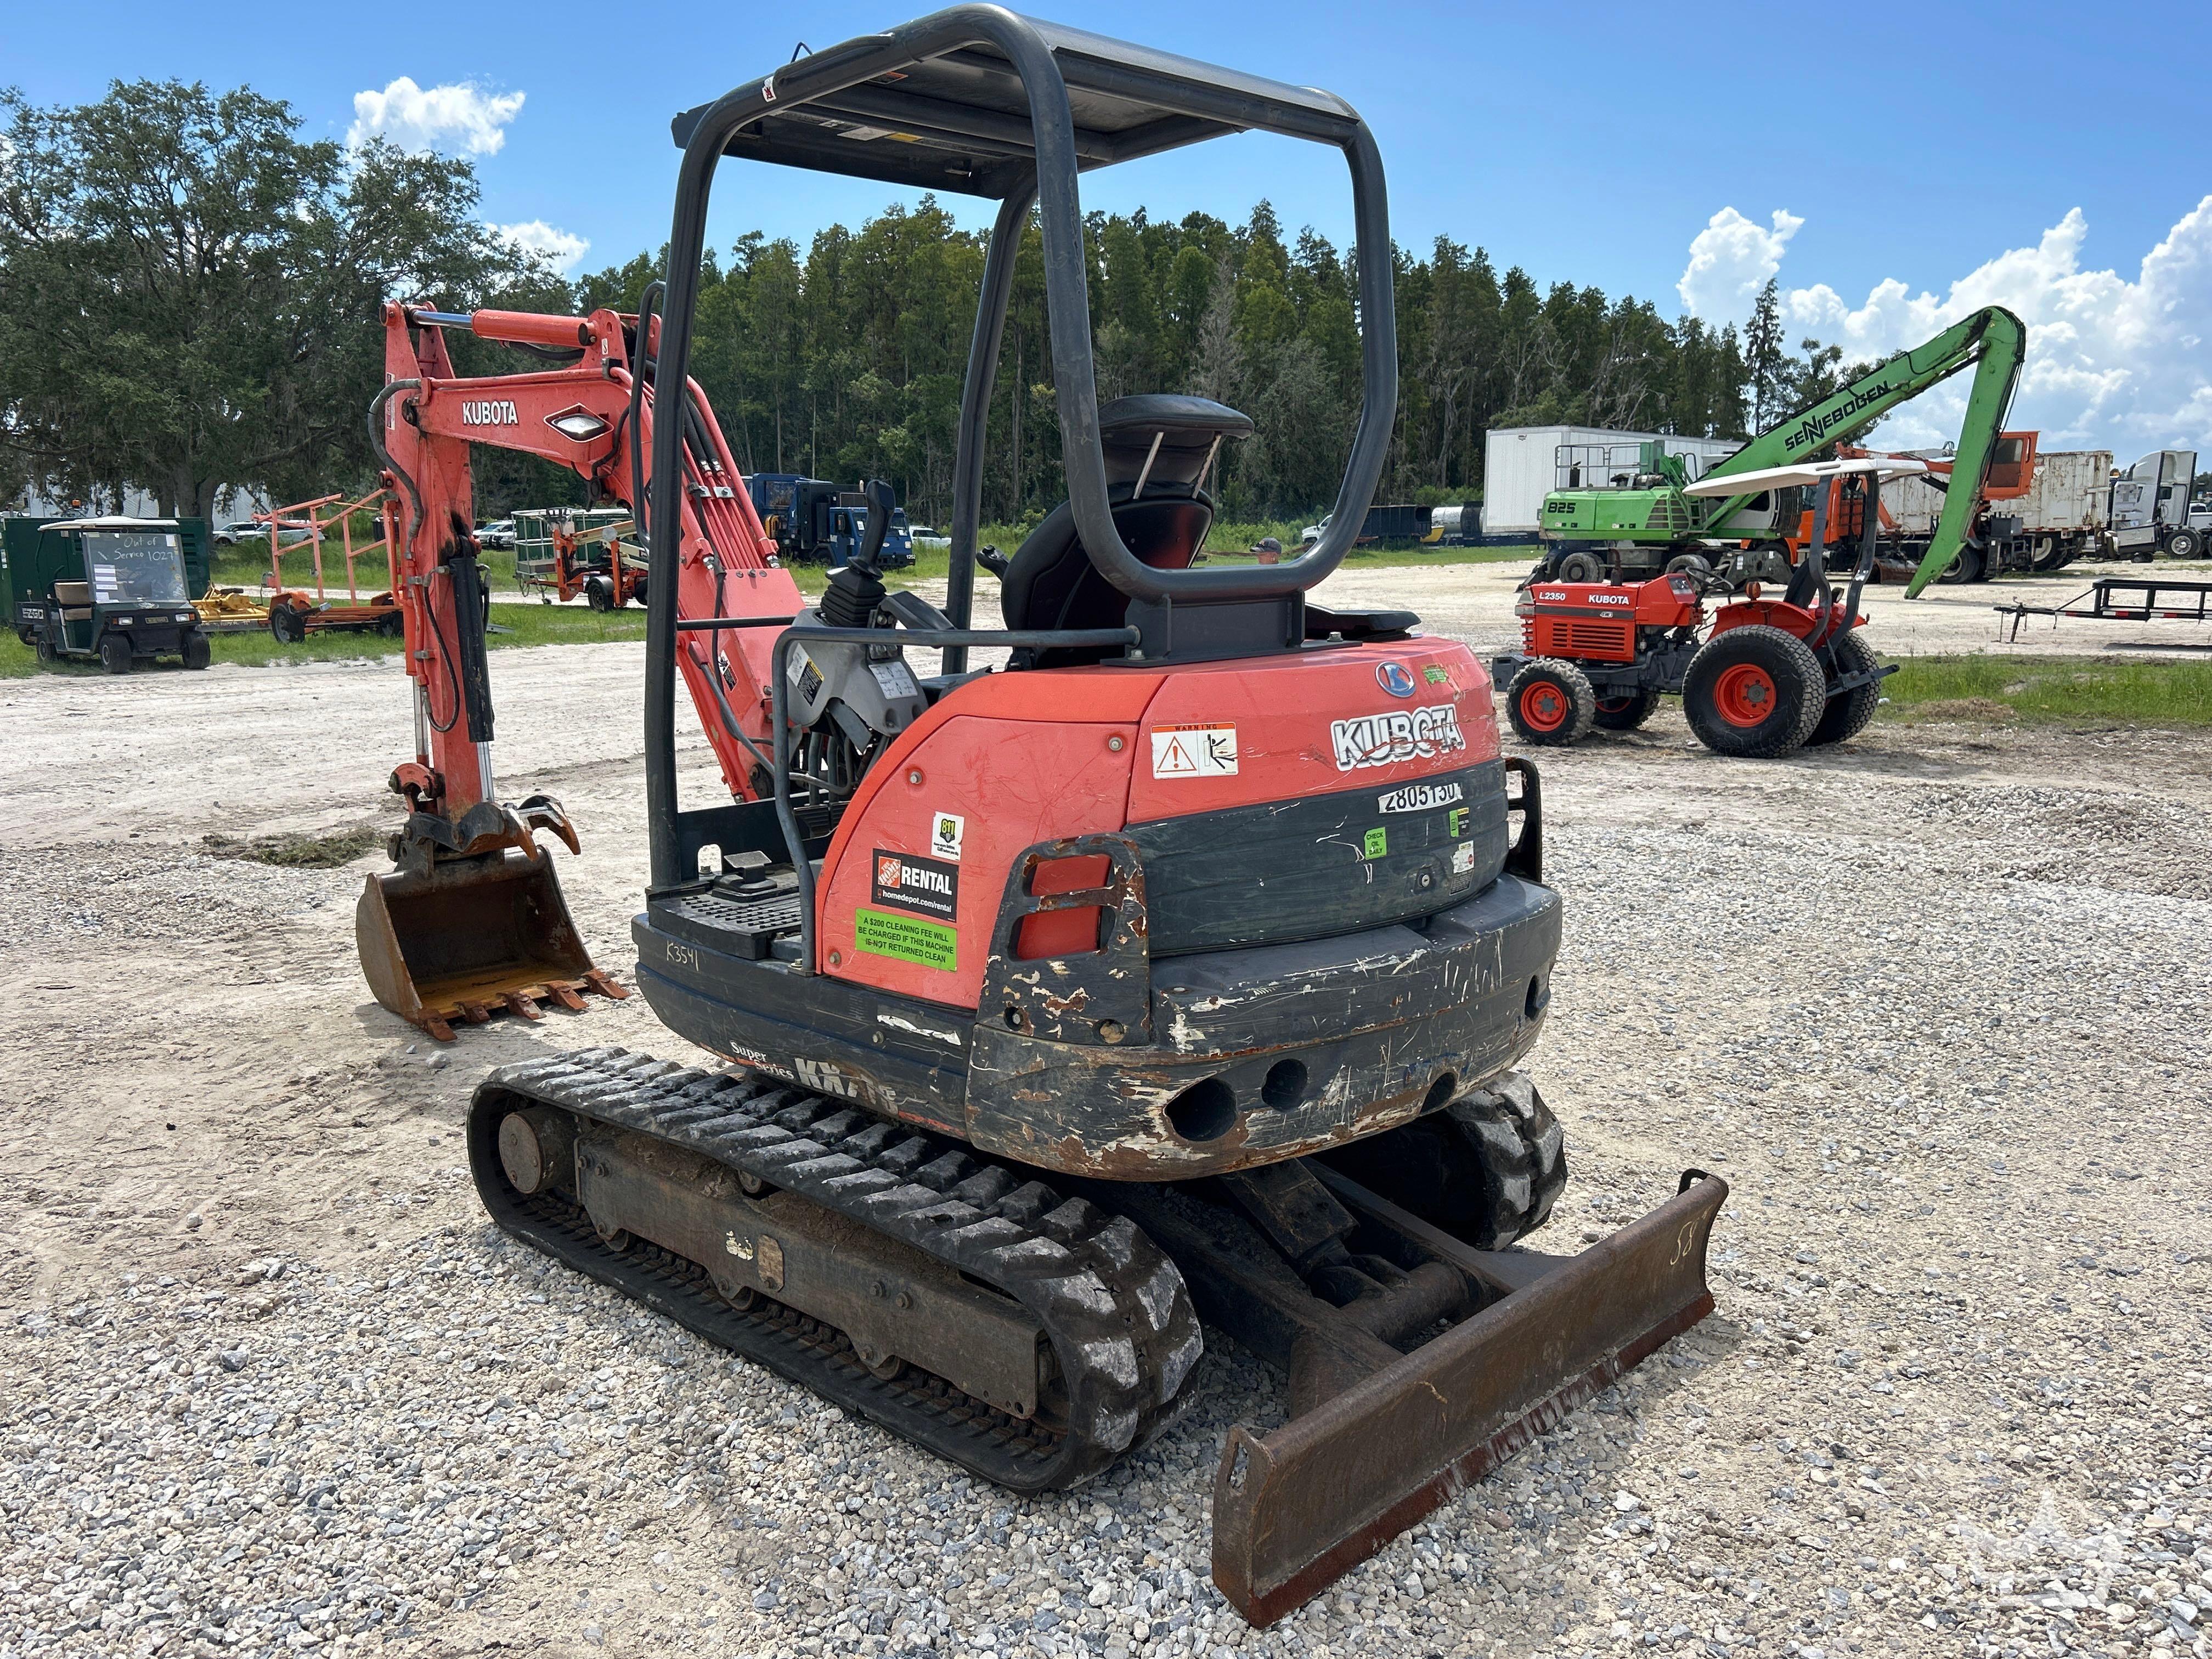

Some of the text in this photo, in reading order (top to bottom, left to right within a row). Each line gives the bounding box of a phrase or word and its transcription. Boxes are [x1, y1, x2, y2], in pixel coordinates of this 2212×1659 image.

[462, 400, 518, 425] KUBOTA
[1785, 380, 1891, 452] SENNEBOGEN
[1548, 502, 1576, 514] 825
[124, 536, 158, 548] Out of
[148, 551, 174, 561] 1027
[1539, 591, 1629, 605] L2350 KUBOTA
[1333, 708, 1463, 766] KUBOTA
[941, 819, 955, 835] 811
[901, 866, 952, 895] RENTAL
[883, 889, 951, 912] homedepot.com/rental
[858, 926, 867, 934] BE
[868, 928, 901, 941] CHARGED
[910, 936, 924, 946] THIS
[926, 940, 954, 954] MACHINE
[870, 918, 884, 928] $200
[886, 921, 919, 935] CLEANING
[921, 929, 933, 937] FEE
[934, 932, 949, 942] WILL
[667, 940, 699, 971] K3541
[873, 940, 887, 949] NOT
[888, 943, 924, 957] RETURNED
[925, 951, 946, 963] CLEAN
[730, 1040, 766, 1062] Super
